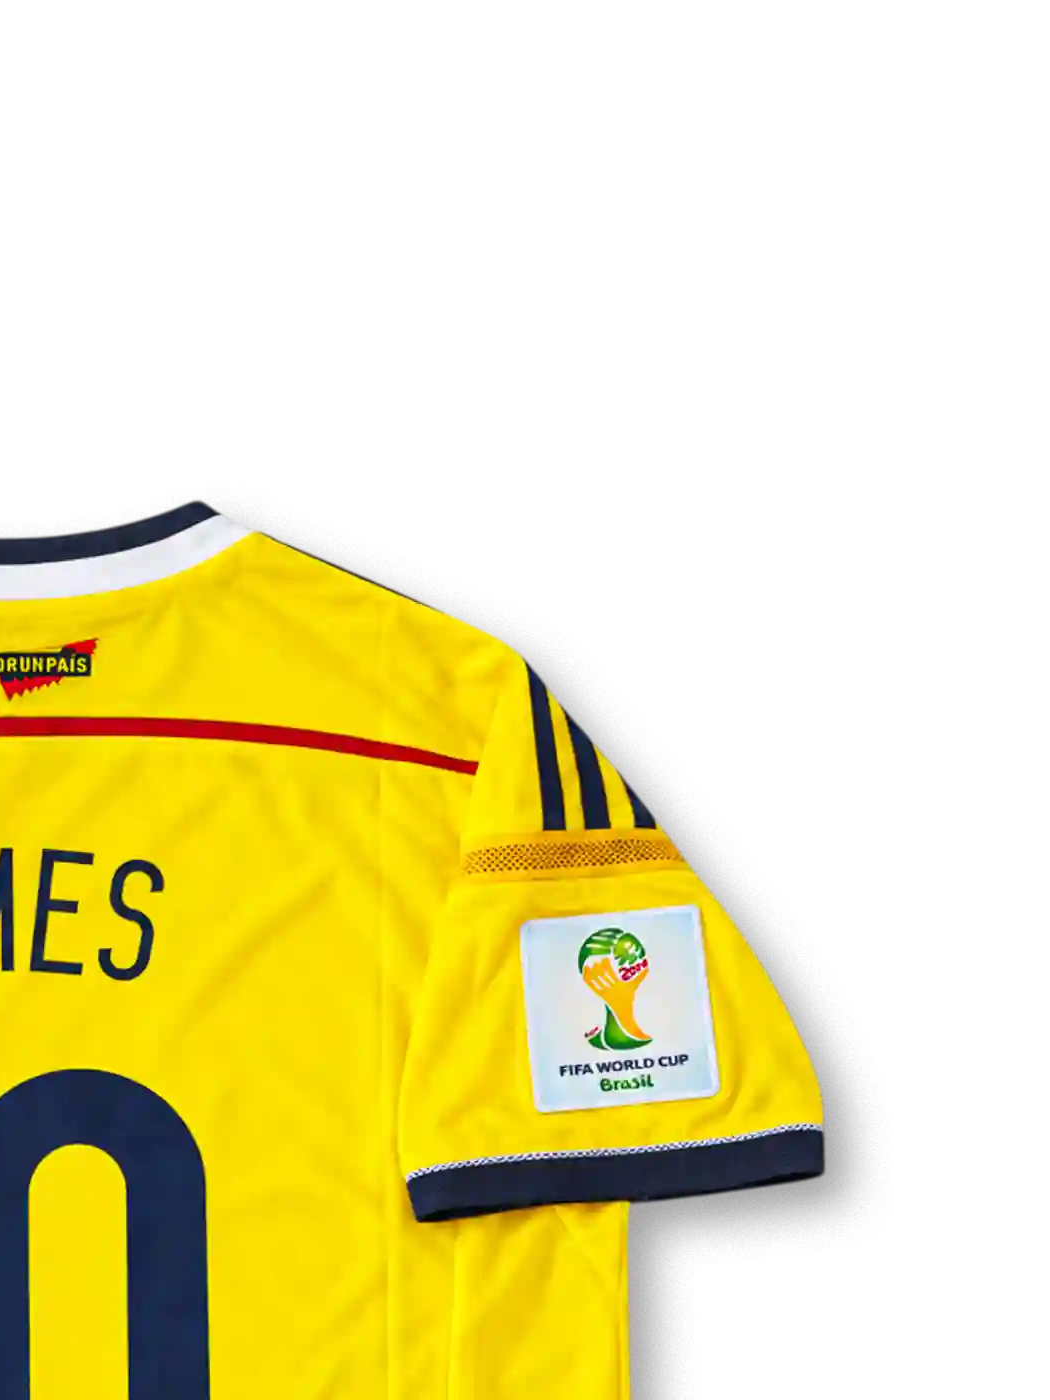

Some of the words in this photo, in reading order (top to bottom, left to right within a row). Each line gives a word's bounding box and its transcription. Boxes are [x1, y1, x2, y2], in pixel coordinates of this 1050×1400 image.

[559, 1063, 594, 1077] FIFA
[595, 1058, 655, 1073] WORLD
[658, 1054, 689, 1067] CUP
[599, 1074, 654, 1092] Brasil
